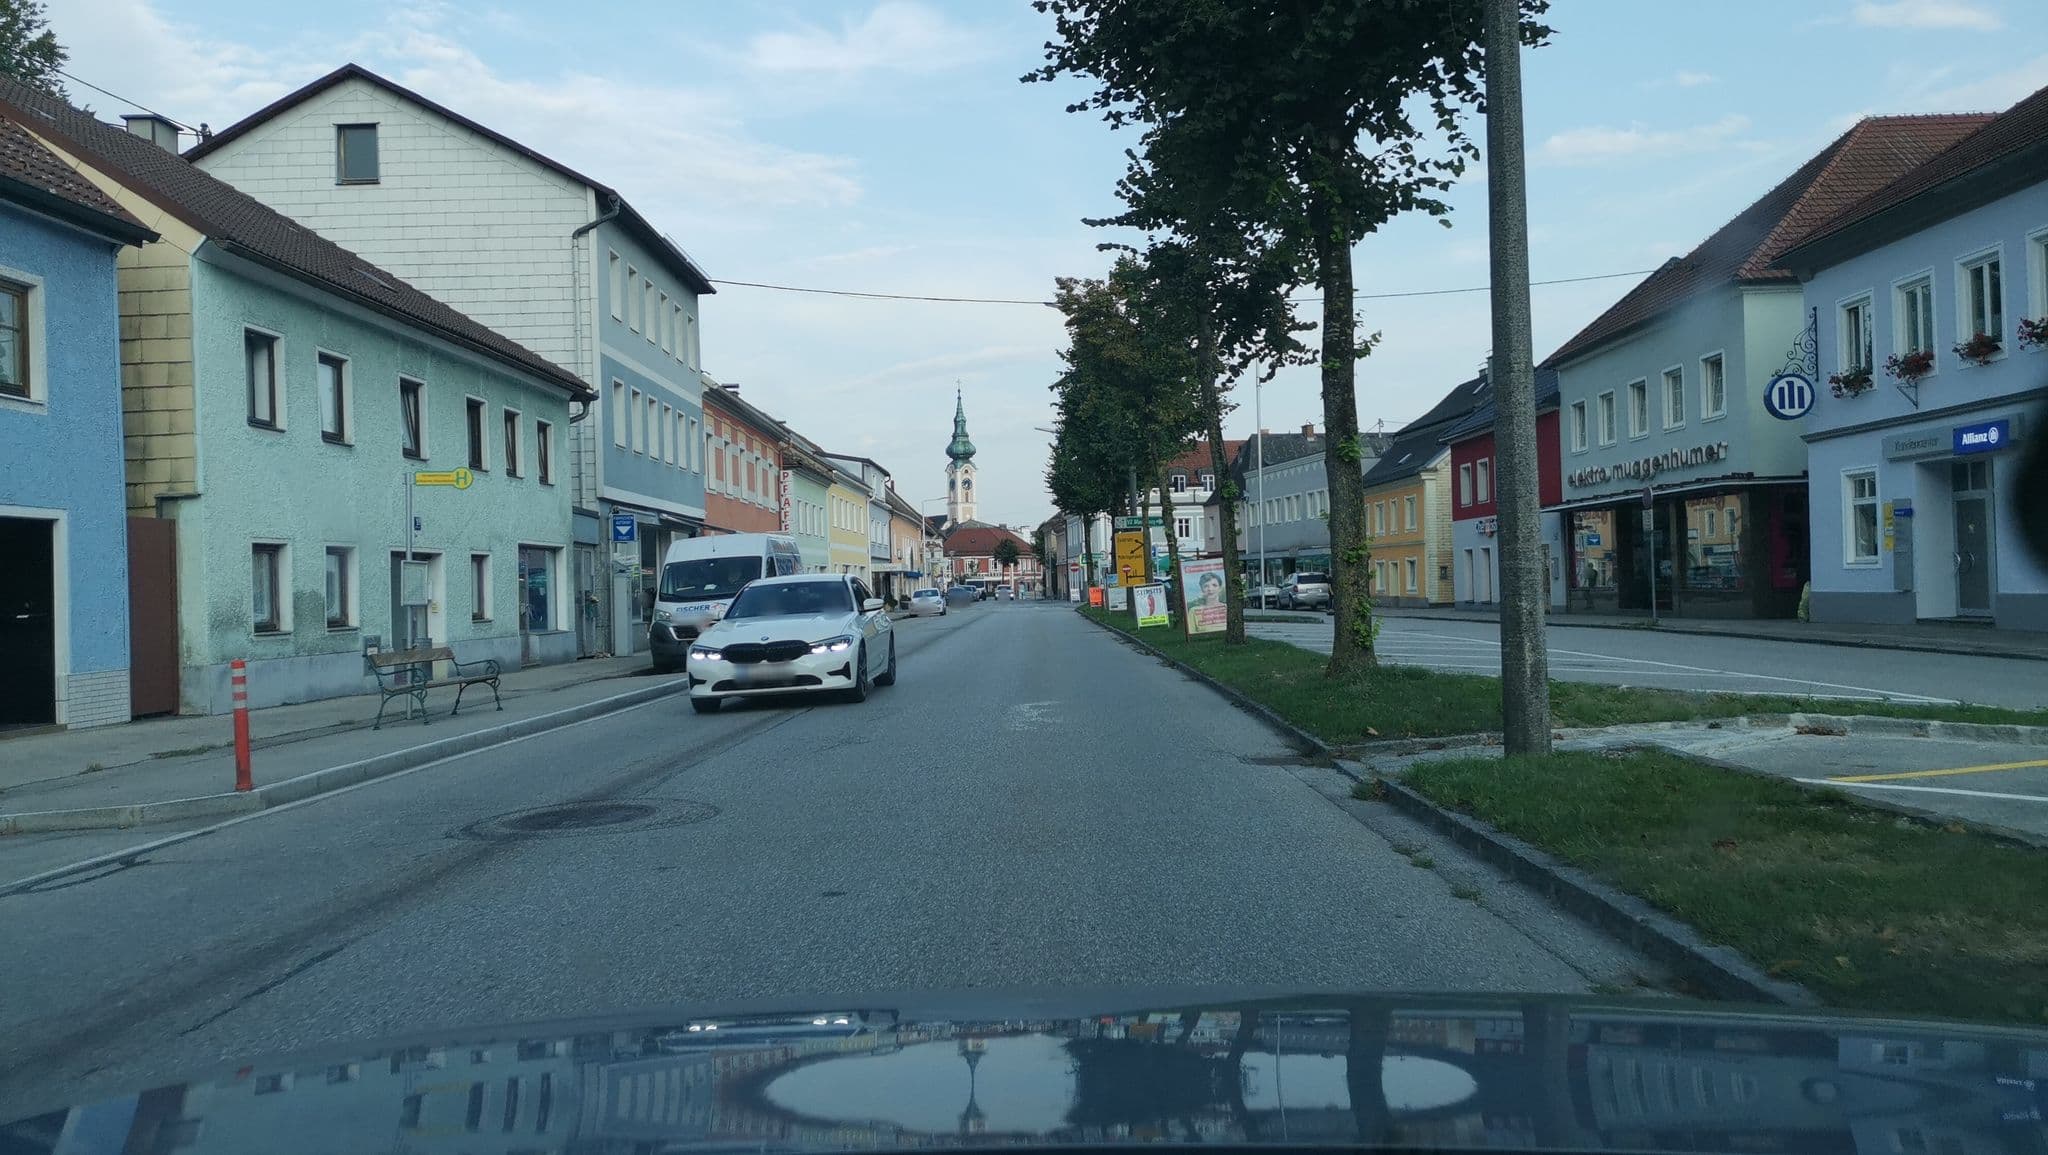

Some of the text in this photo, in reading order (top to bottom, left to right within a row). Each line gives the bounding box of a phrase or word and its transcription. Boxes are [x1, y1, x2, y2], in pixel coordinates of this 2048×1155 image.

[1961, 432, 1988, 445] Allianz
[1567, 441, 1728, 488] elektro muggenhumer
[782, 471, 791, 532] PFAFF
[676, 604, 711, 613] FISCHER
